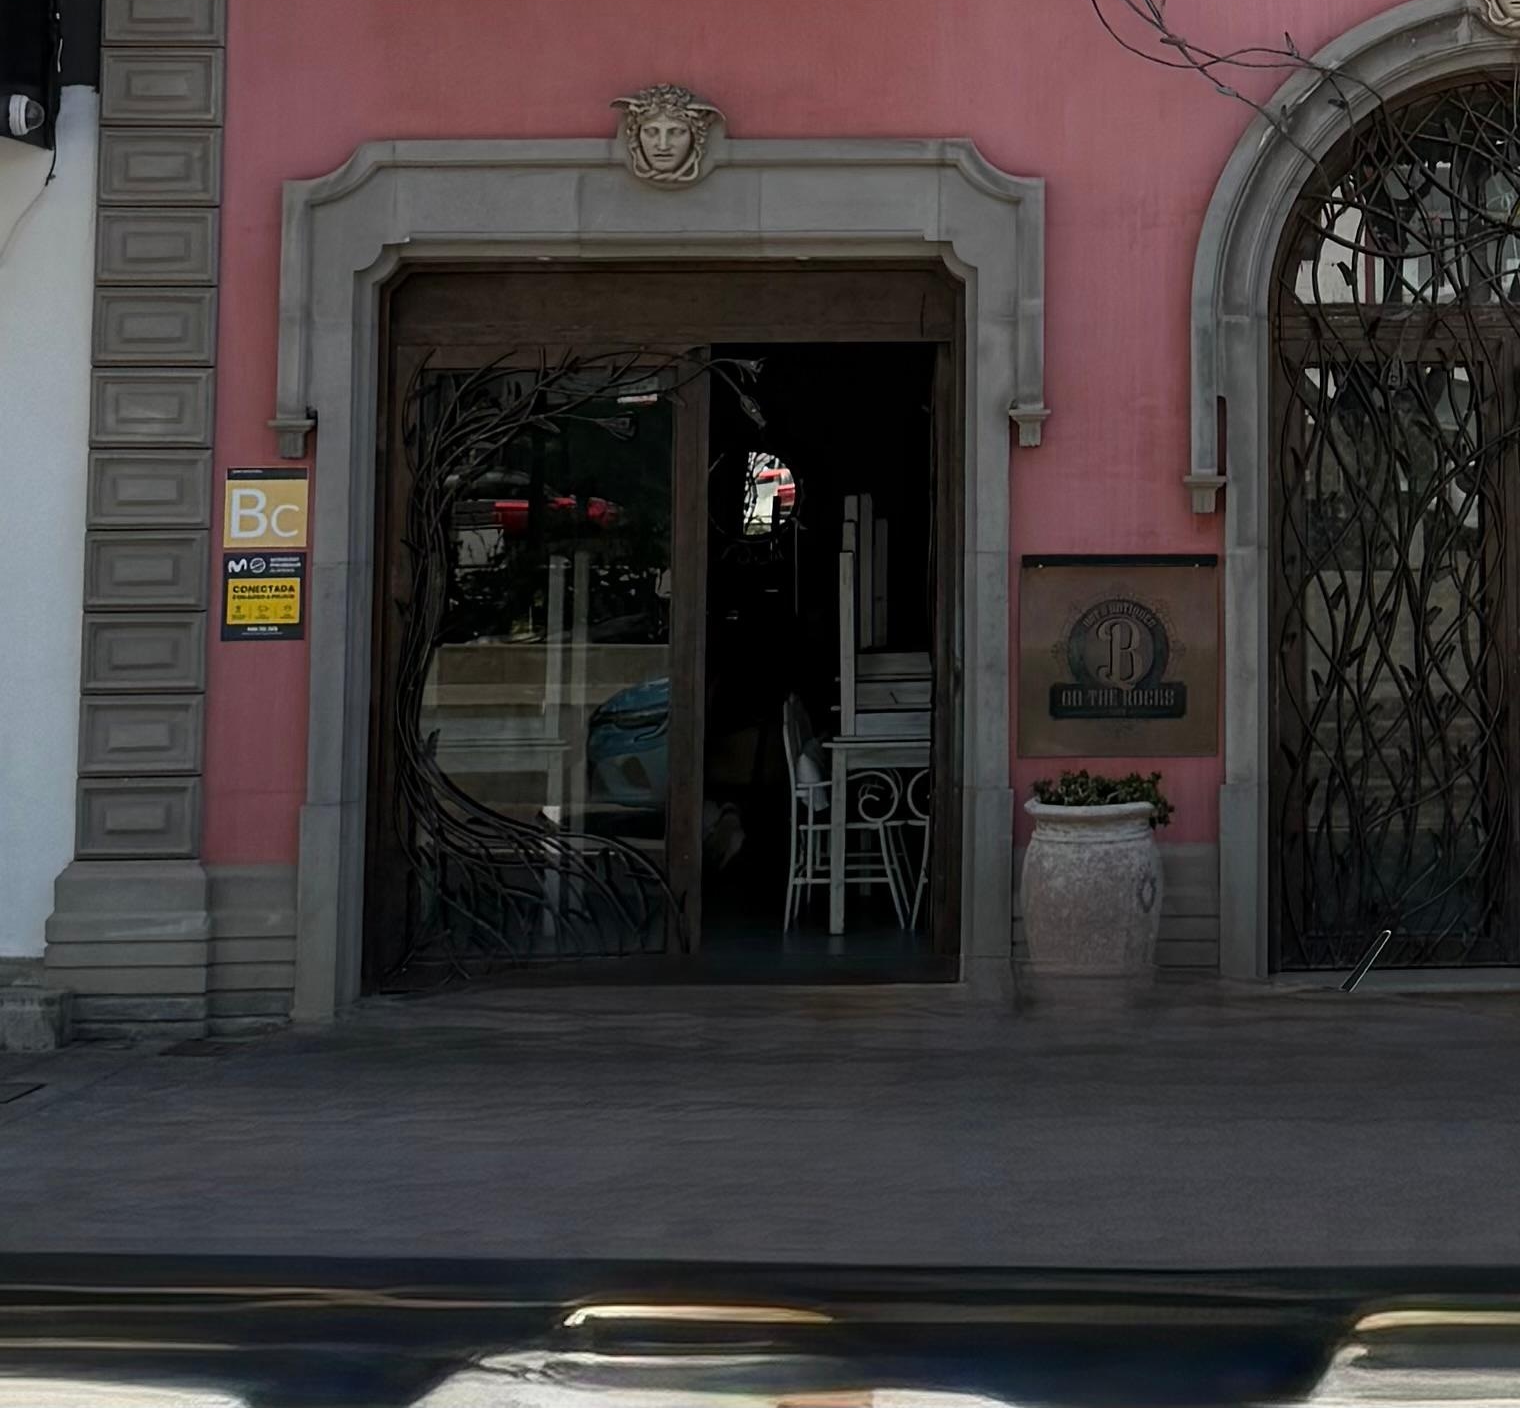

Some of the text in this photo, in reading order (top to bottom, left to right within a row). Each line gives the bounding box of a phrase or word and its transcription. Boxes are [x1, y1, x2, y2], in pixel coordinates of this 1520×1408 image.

[233, 585, 295, 593] CONECTADA
[1088, 689, 1118, 706] THE
[1123, 689, 1175, 706] ROCKS
